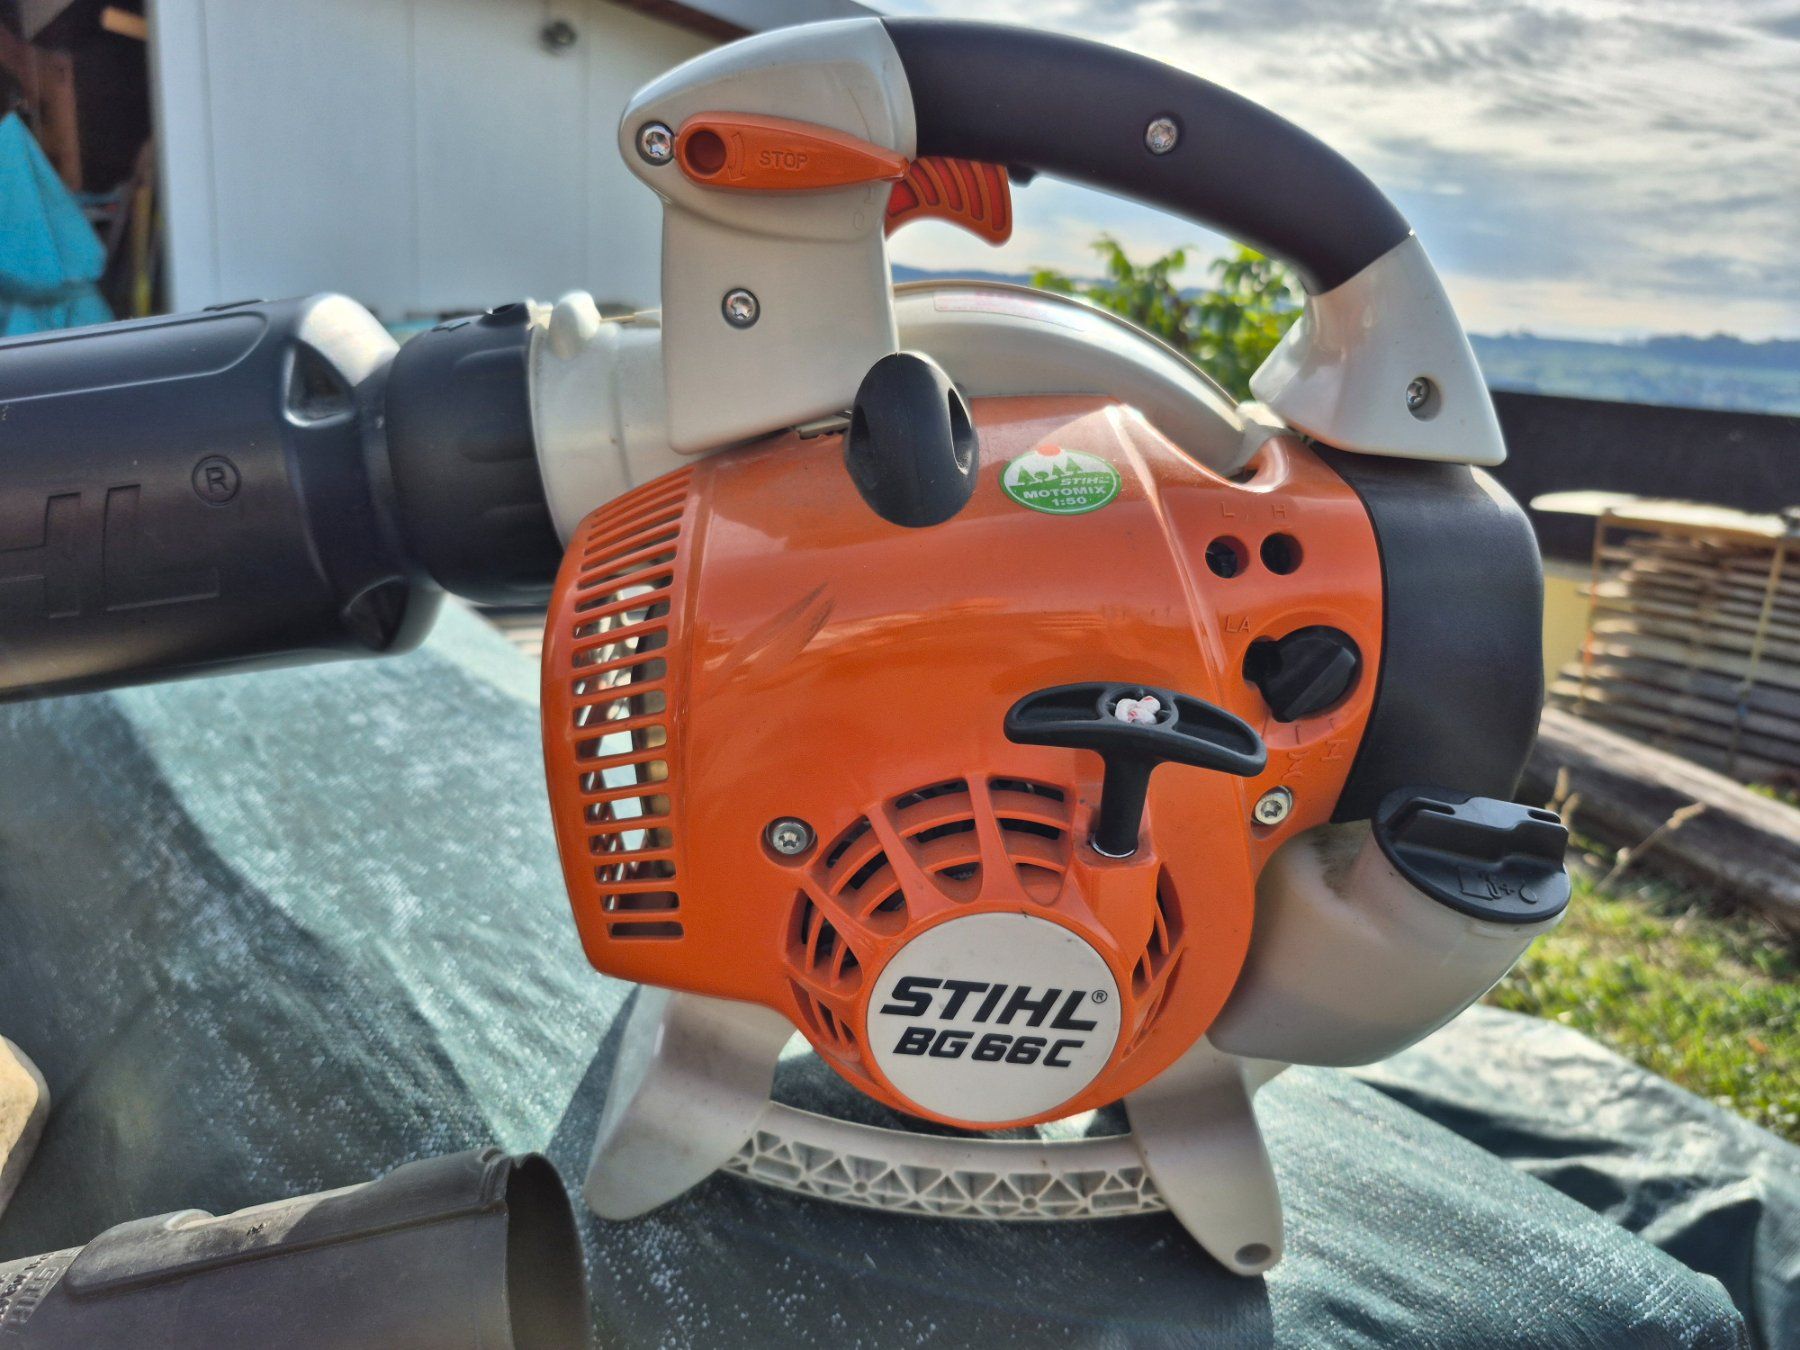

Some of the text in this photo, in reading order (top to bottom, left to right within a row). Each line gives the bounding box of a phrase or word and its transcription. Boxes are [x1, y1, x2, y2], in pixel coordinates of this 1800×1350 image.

[759, 150, 808, 169] STOP
[1023, 486, 1106, 499] MOTOMIX
[1051, 496, 1087, 507] 1:50
[1271, 503, 1287, 519] H
[1225, 615, 1250, 633] LA
